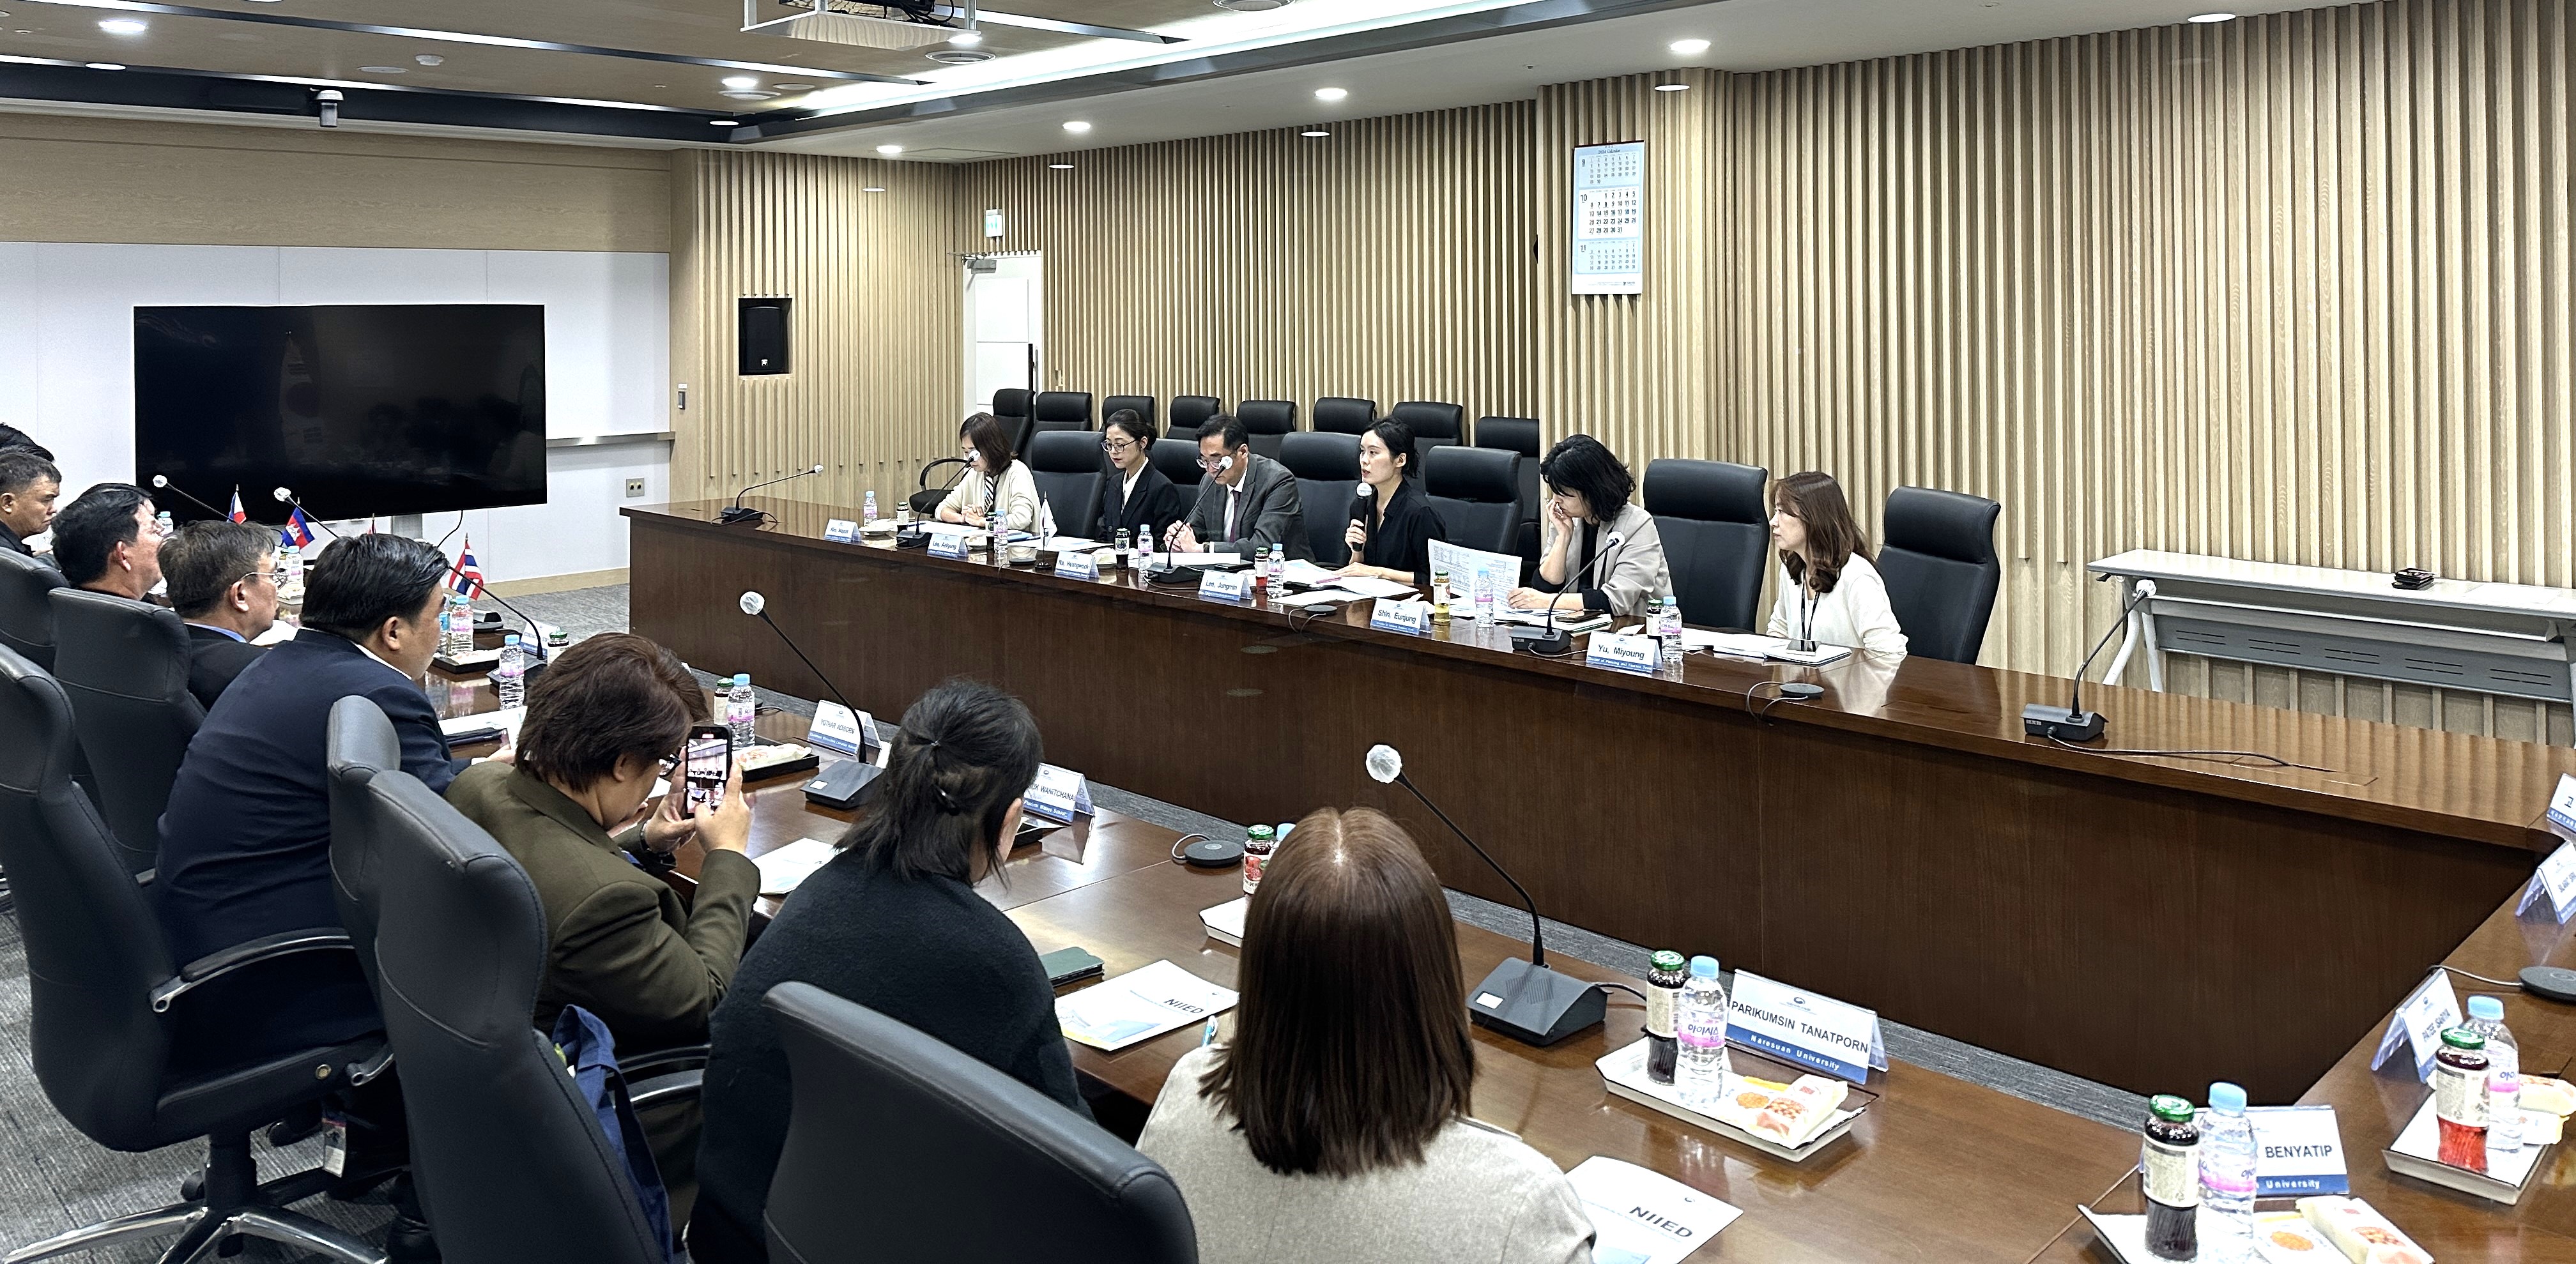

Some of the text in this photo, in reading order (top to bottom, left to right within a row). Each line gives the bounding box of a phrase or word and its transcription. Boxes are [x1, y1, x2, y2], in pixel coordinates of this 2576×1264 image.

[1217, 581, 1238, 591] Jungmin
[1378, 610, 1416, 624] Shin, Eunjung
[1598, 644, 1645, 660] Yu, Miyoung
[1164, 998, 1204, 1014] NIIED
[1731, 1001, 1795, 1030] PARIKUMSIN
[1801, 1023, 1869, 1053] TANATPORN
[1750, 1034, 1840, 1071] Naresuan University
[2265, 1145, 2332, 1158] BENYATIP
[2266, 1179, 2320, 1190] University
[1629, 1206, 1693, 1237] NIIED
